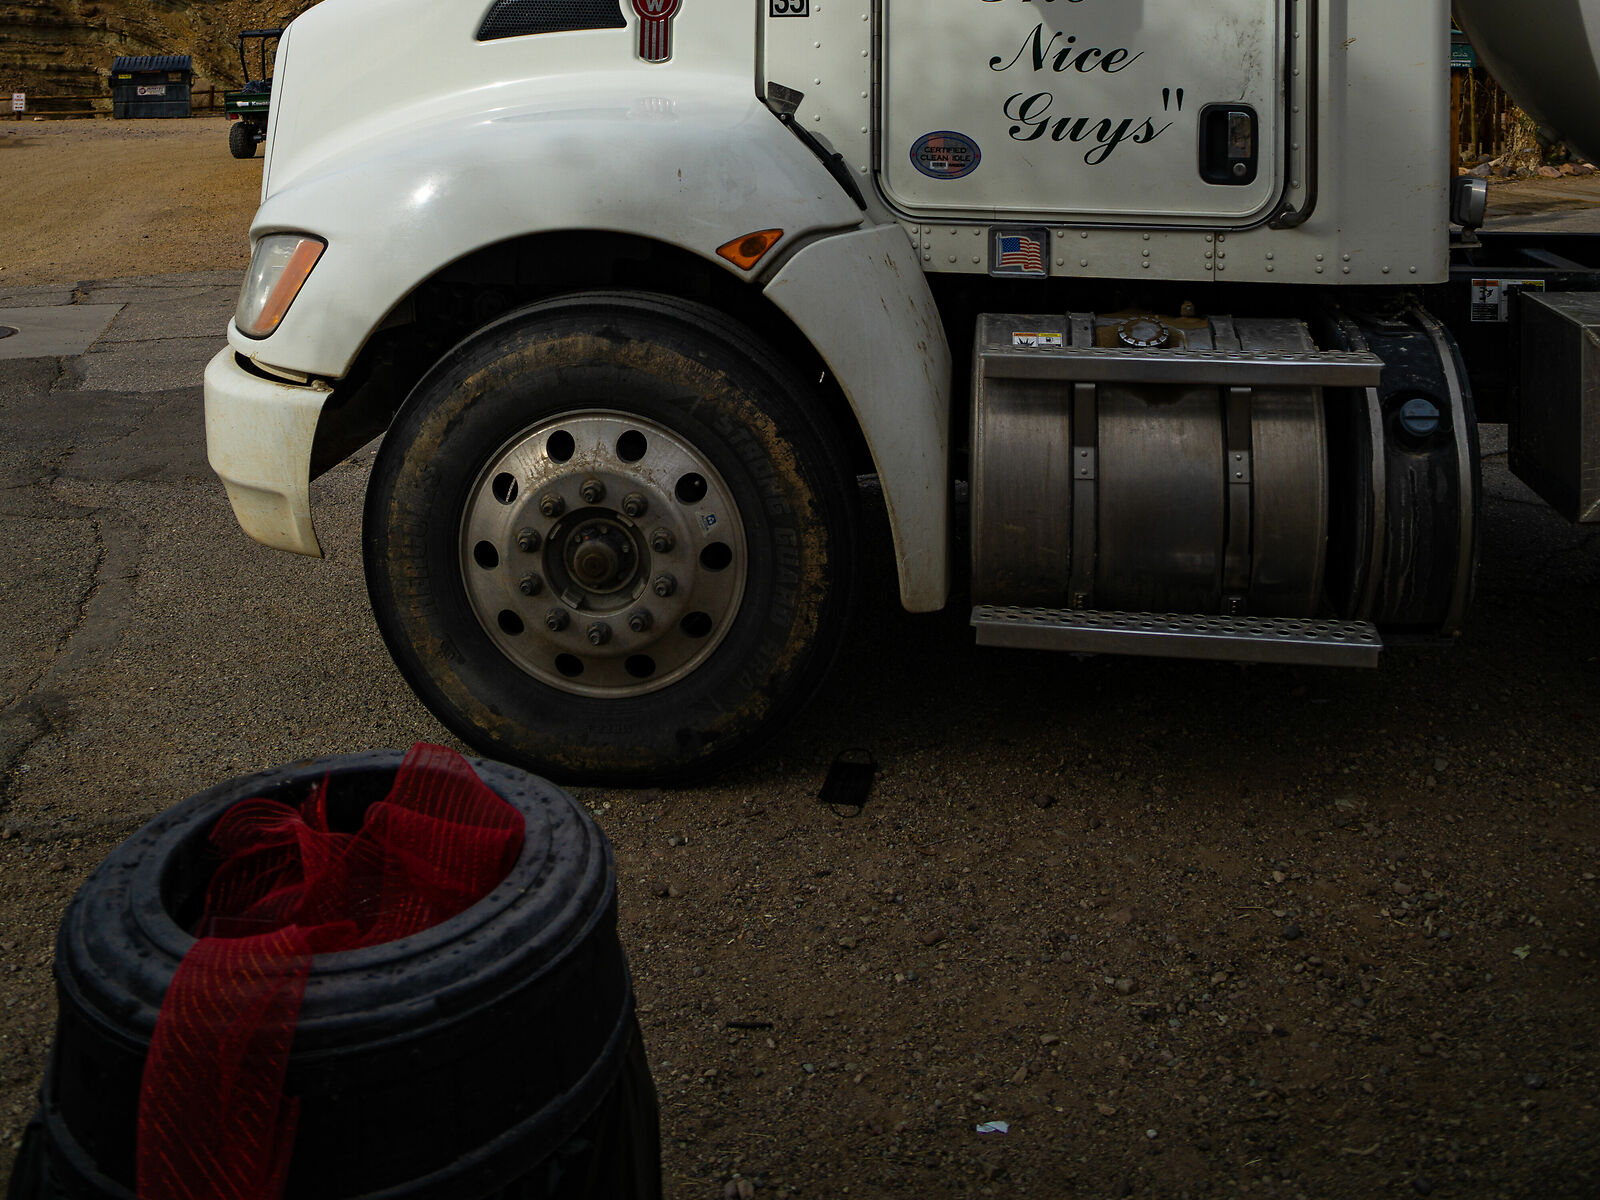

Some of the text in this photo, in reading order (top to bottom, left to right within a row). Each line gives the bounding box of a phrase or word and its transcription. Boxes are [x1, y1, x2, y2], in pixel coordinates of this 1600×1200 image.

[988, 23, 1144, 73] Nice
[924, 146, 967, 154] CERTIFIED
[920, 153, 949, 161] CLEAN
